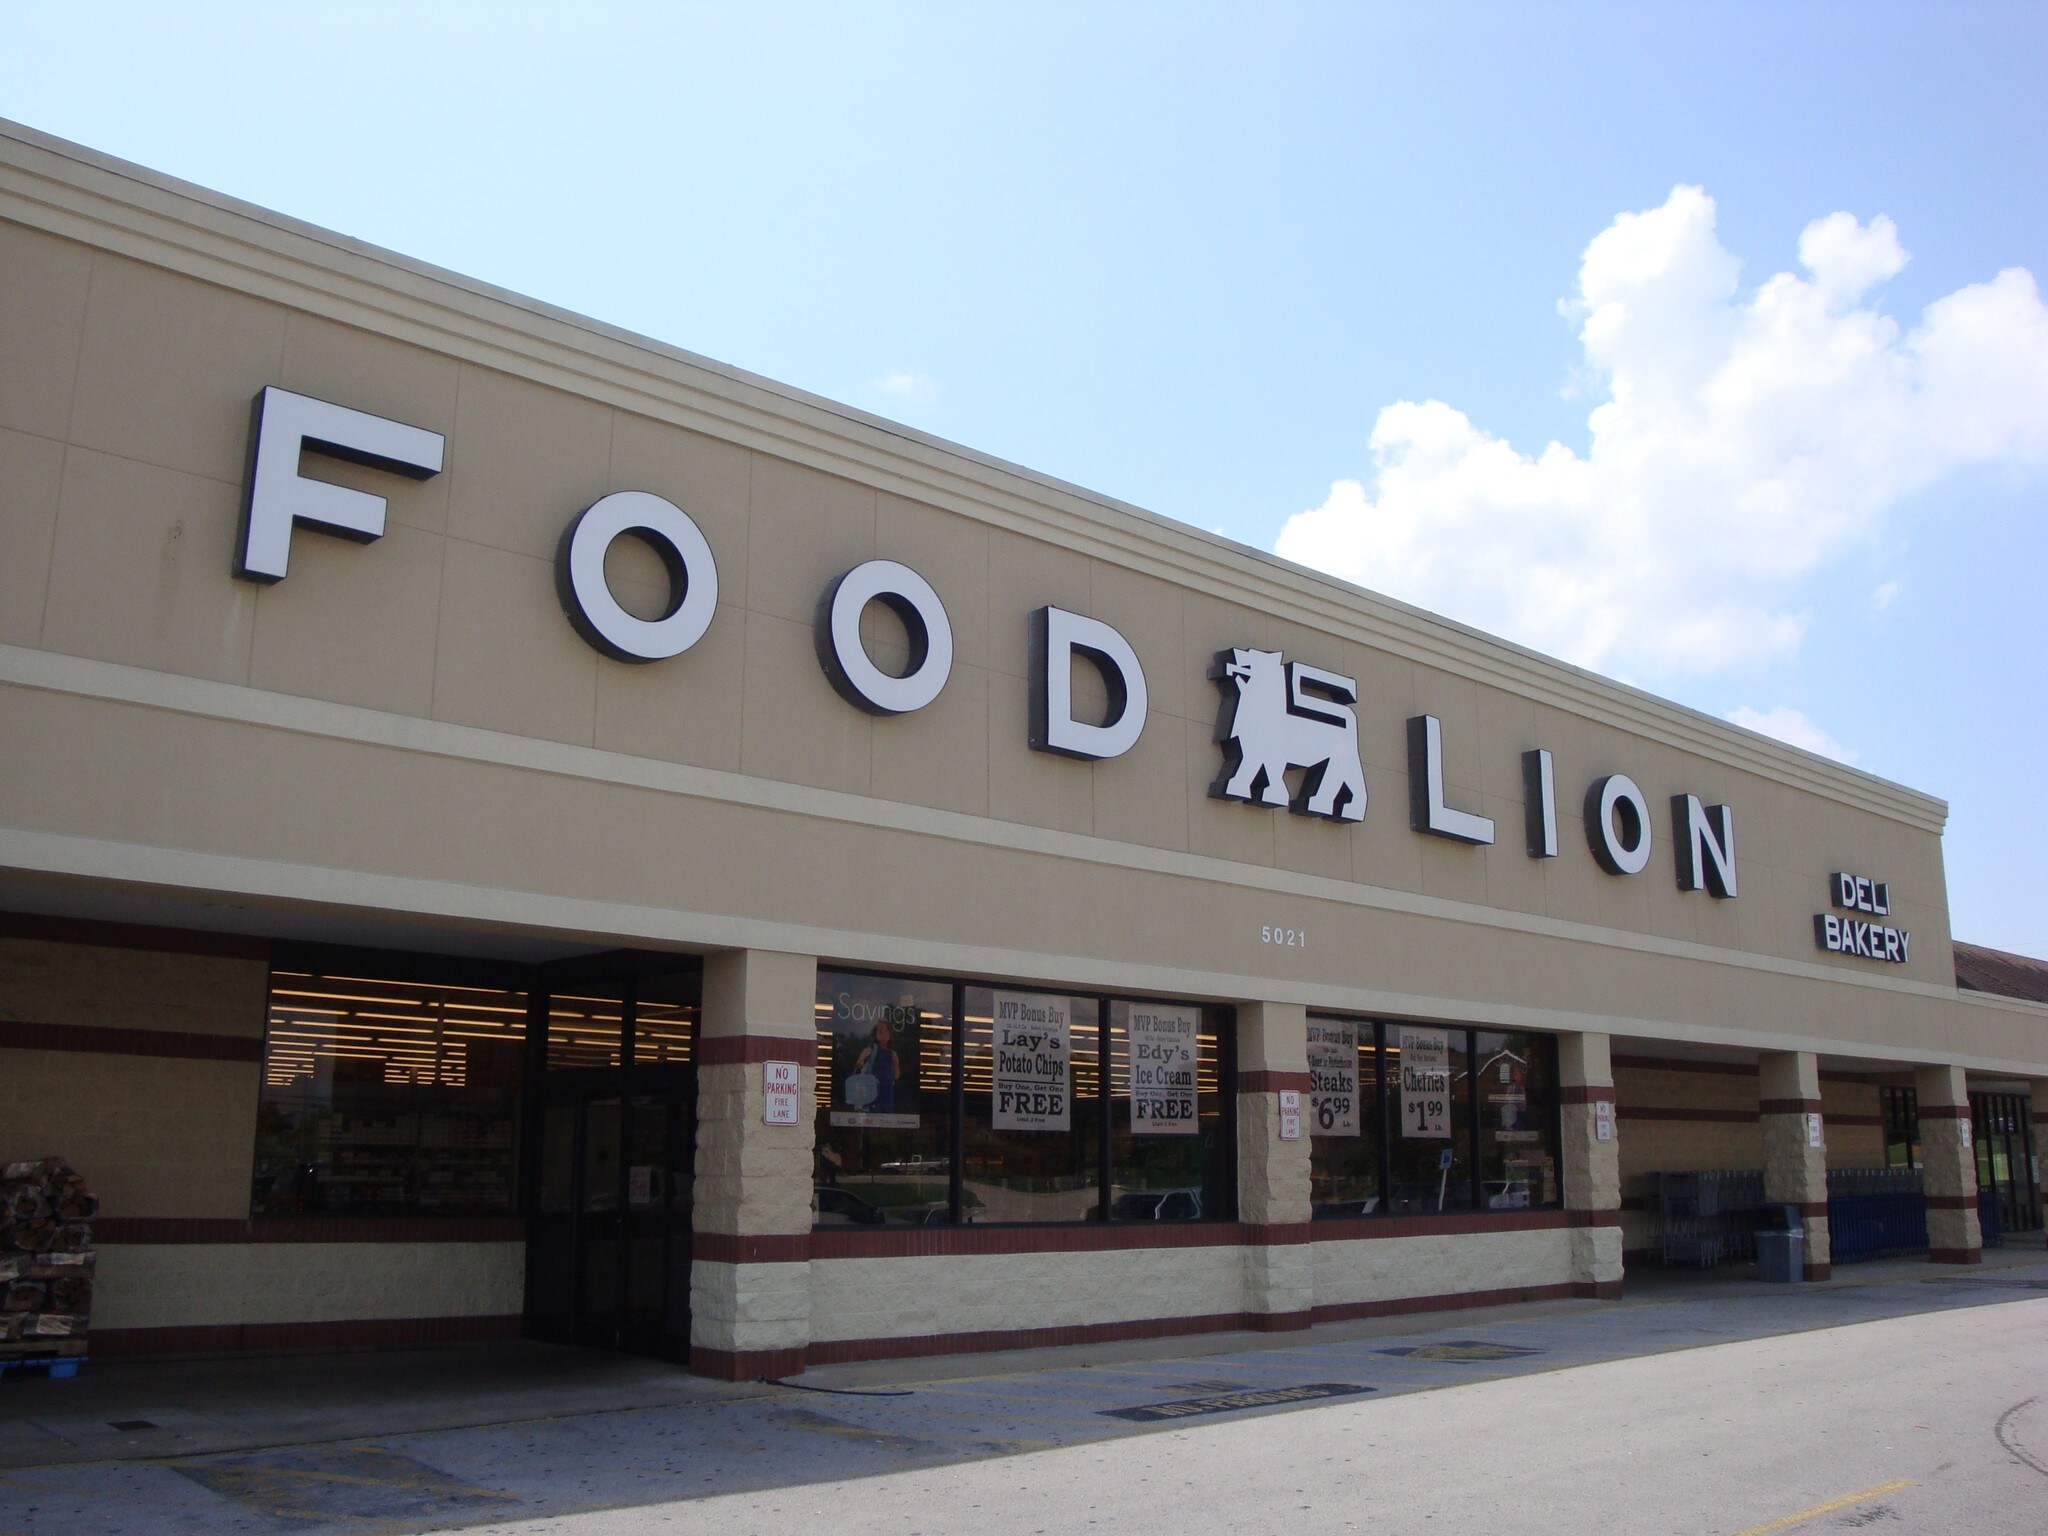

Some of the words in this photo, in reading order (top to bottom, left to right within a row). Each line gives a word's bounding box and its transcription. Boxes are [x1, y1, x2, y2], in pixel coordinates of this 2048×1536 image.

[234, 384, 1149, 762] FOOD
[1407, 713, 1738, 899] LION
[1834, 872, 1891, 916] DELI
[1261, 925, 1305, 948] 5021
[1819, 913, 1910, 963] BAKERY
[837, 992, 916, 1033] Savings
[999, 1001, 1020, 1020] MVP
[1021, 1003, 1046, 1023] Bonus
[1048, 1006, 1065, 1030] Buy
[1133, 1014, 1151, 1032] MVP
[1153, 1016, 1175, 1033] Bonus
[1177, 1017, 1191, 1038] Buy
[1002, 1029, 1061, 1053] Lay's
[999, 1051, 1033, 1075] Potato
[1035, 1054, 1064, 1081] Chips
[1137, 1044, 1190, 1064] Edy's
[775, 1067, 789, 1080] NO
[1136, 1064, 1152, 1085] Ice
[1156, 1065, 1191, 1085] Cream
[1310, 1069, 1353, 1093] Steaks
[1403, 1066, 1445, 1093] Cherries
[767, 1082, 797, 1095] PARKING
[998, 1082, 1013, 1091] Buy
[773, 1109, 789, 1119] LANE
[774, 1098, 789, 1106] FIRE
[999, 1091, 1064, 1116] FREE
[1137, 1098, 1193, 1119] FREE
